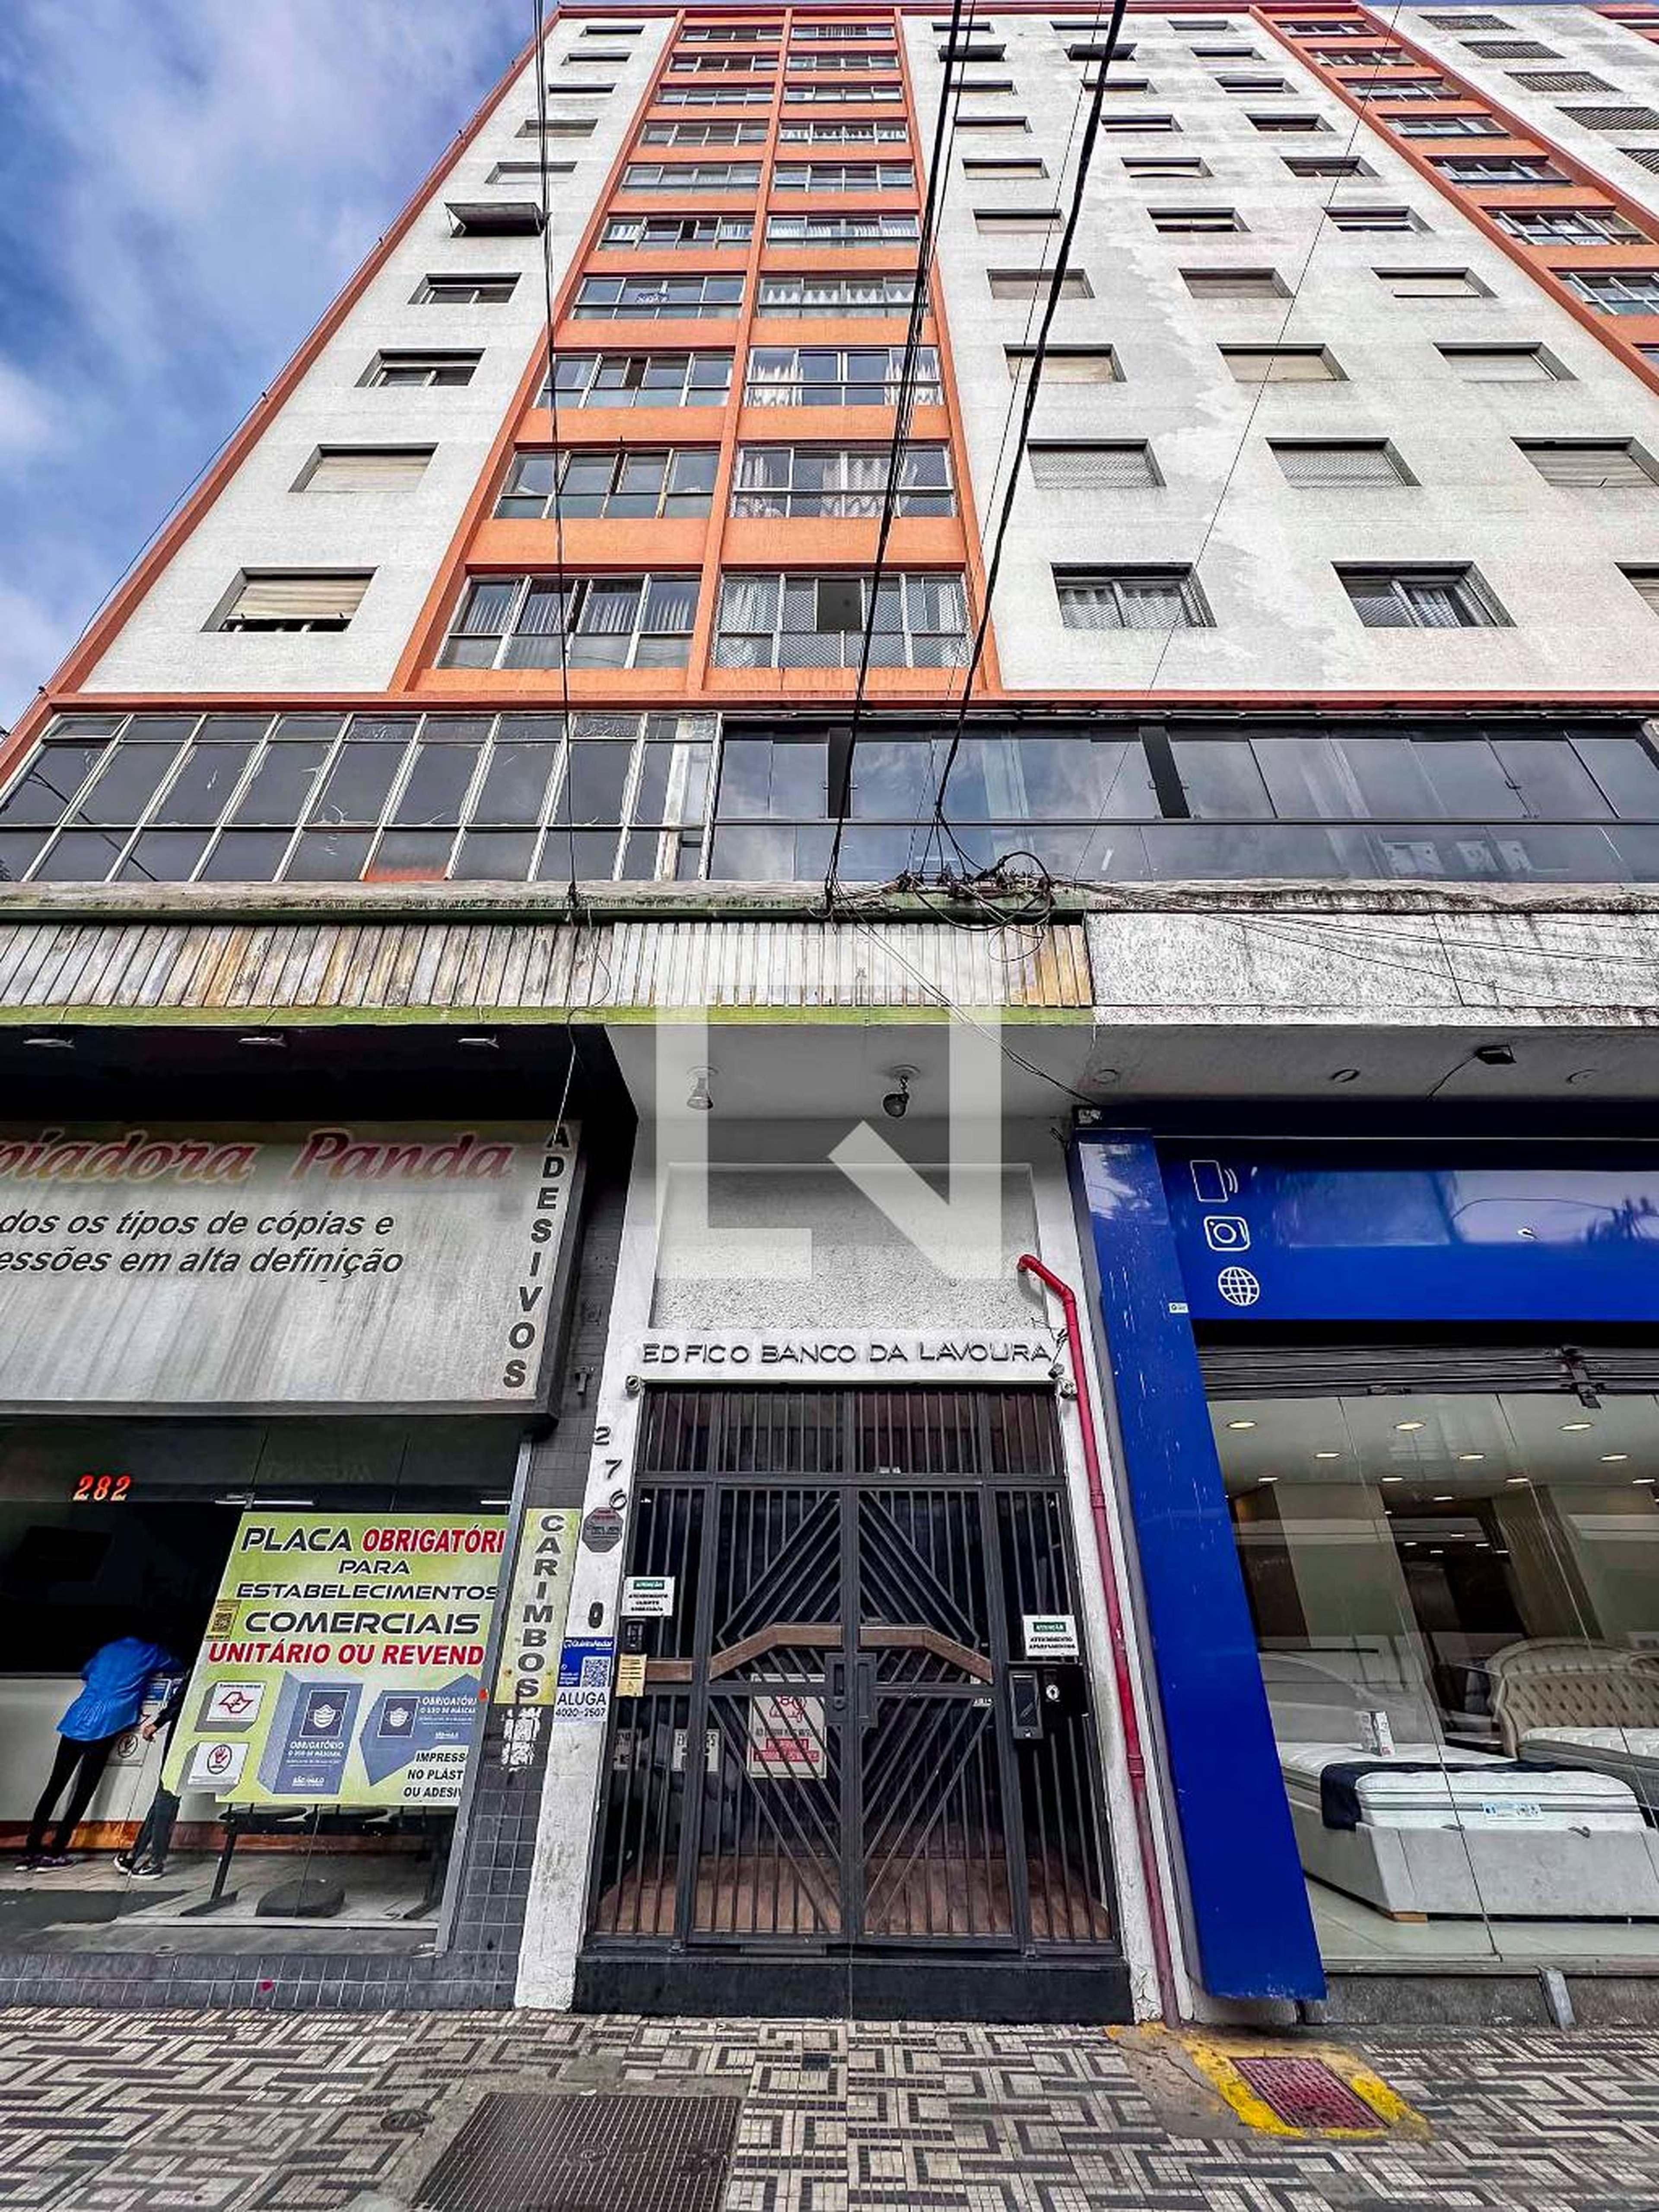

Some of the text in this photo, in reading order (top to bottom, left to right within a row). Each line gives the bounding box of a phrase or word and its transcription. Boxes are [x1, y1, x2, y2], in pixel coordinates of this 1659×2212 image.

[290, 1129, 515, 1181] Panda
[0, 1209, 394, 1241] dos os tipos de cópias e
[119, 1252, 172, 1272] em
[178, 1247, 241, 1273] alta
[249, 1247, 404, 1279] definição
[503, 1126, 570, 1388] ADESIVOS
[761, 1344, 856, 1363] BANCO
[870, 1344, 907, 1362] DA
[920, 1342, 1052, 1362] LAVOURA
[594, 1426, 627, 1510] 276
[72, 1474, 131, 1501] 282
[241, 1528, 352, 1551] PLACA
[338, 1560, 410, 1574] PARA
[236, 1583, 499, 1600] ESTABELECIMENTOS
[515, 1515, 564, 1697] CARIMBOS
[245, 1611, 480, 1634] COMERCIAIS
[209, 1639, 484, 1665] UNITÁRIO OU REVEND
[556, 1692, 607, 1706] ALUGA
[407, 1770, 424, 1780] NO
[404, 1787, 421, 1798] OU
